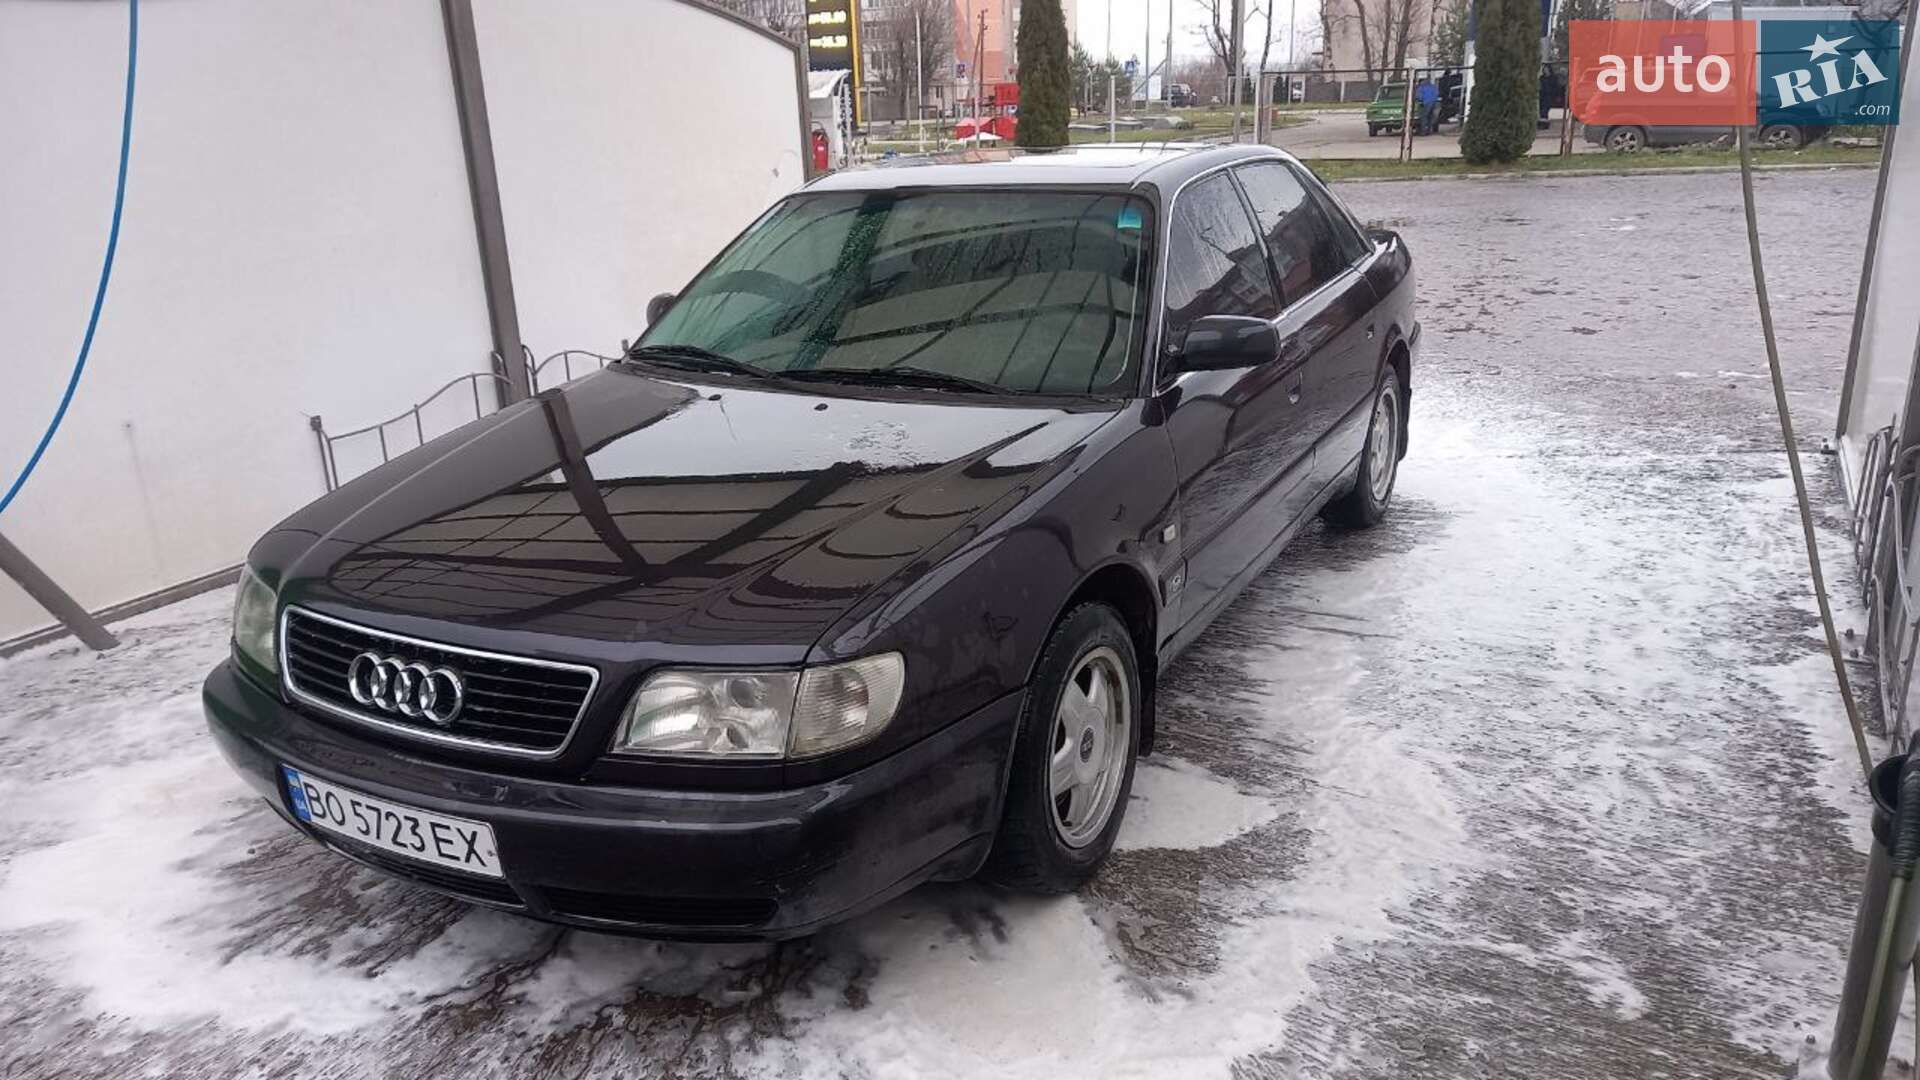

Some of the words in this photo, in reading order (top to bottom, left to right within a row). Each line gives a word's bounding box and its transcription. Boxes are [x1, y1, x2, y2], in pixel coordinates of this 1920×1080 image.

[303, 782, 346, 826] BO
[350, 799, 425, 852] 5723
[429, 821, 488, 868] EX
